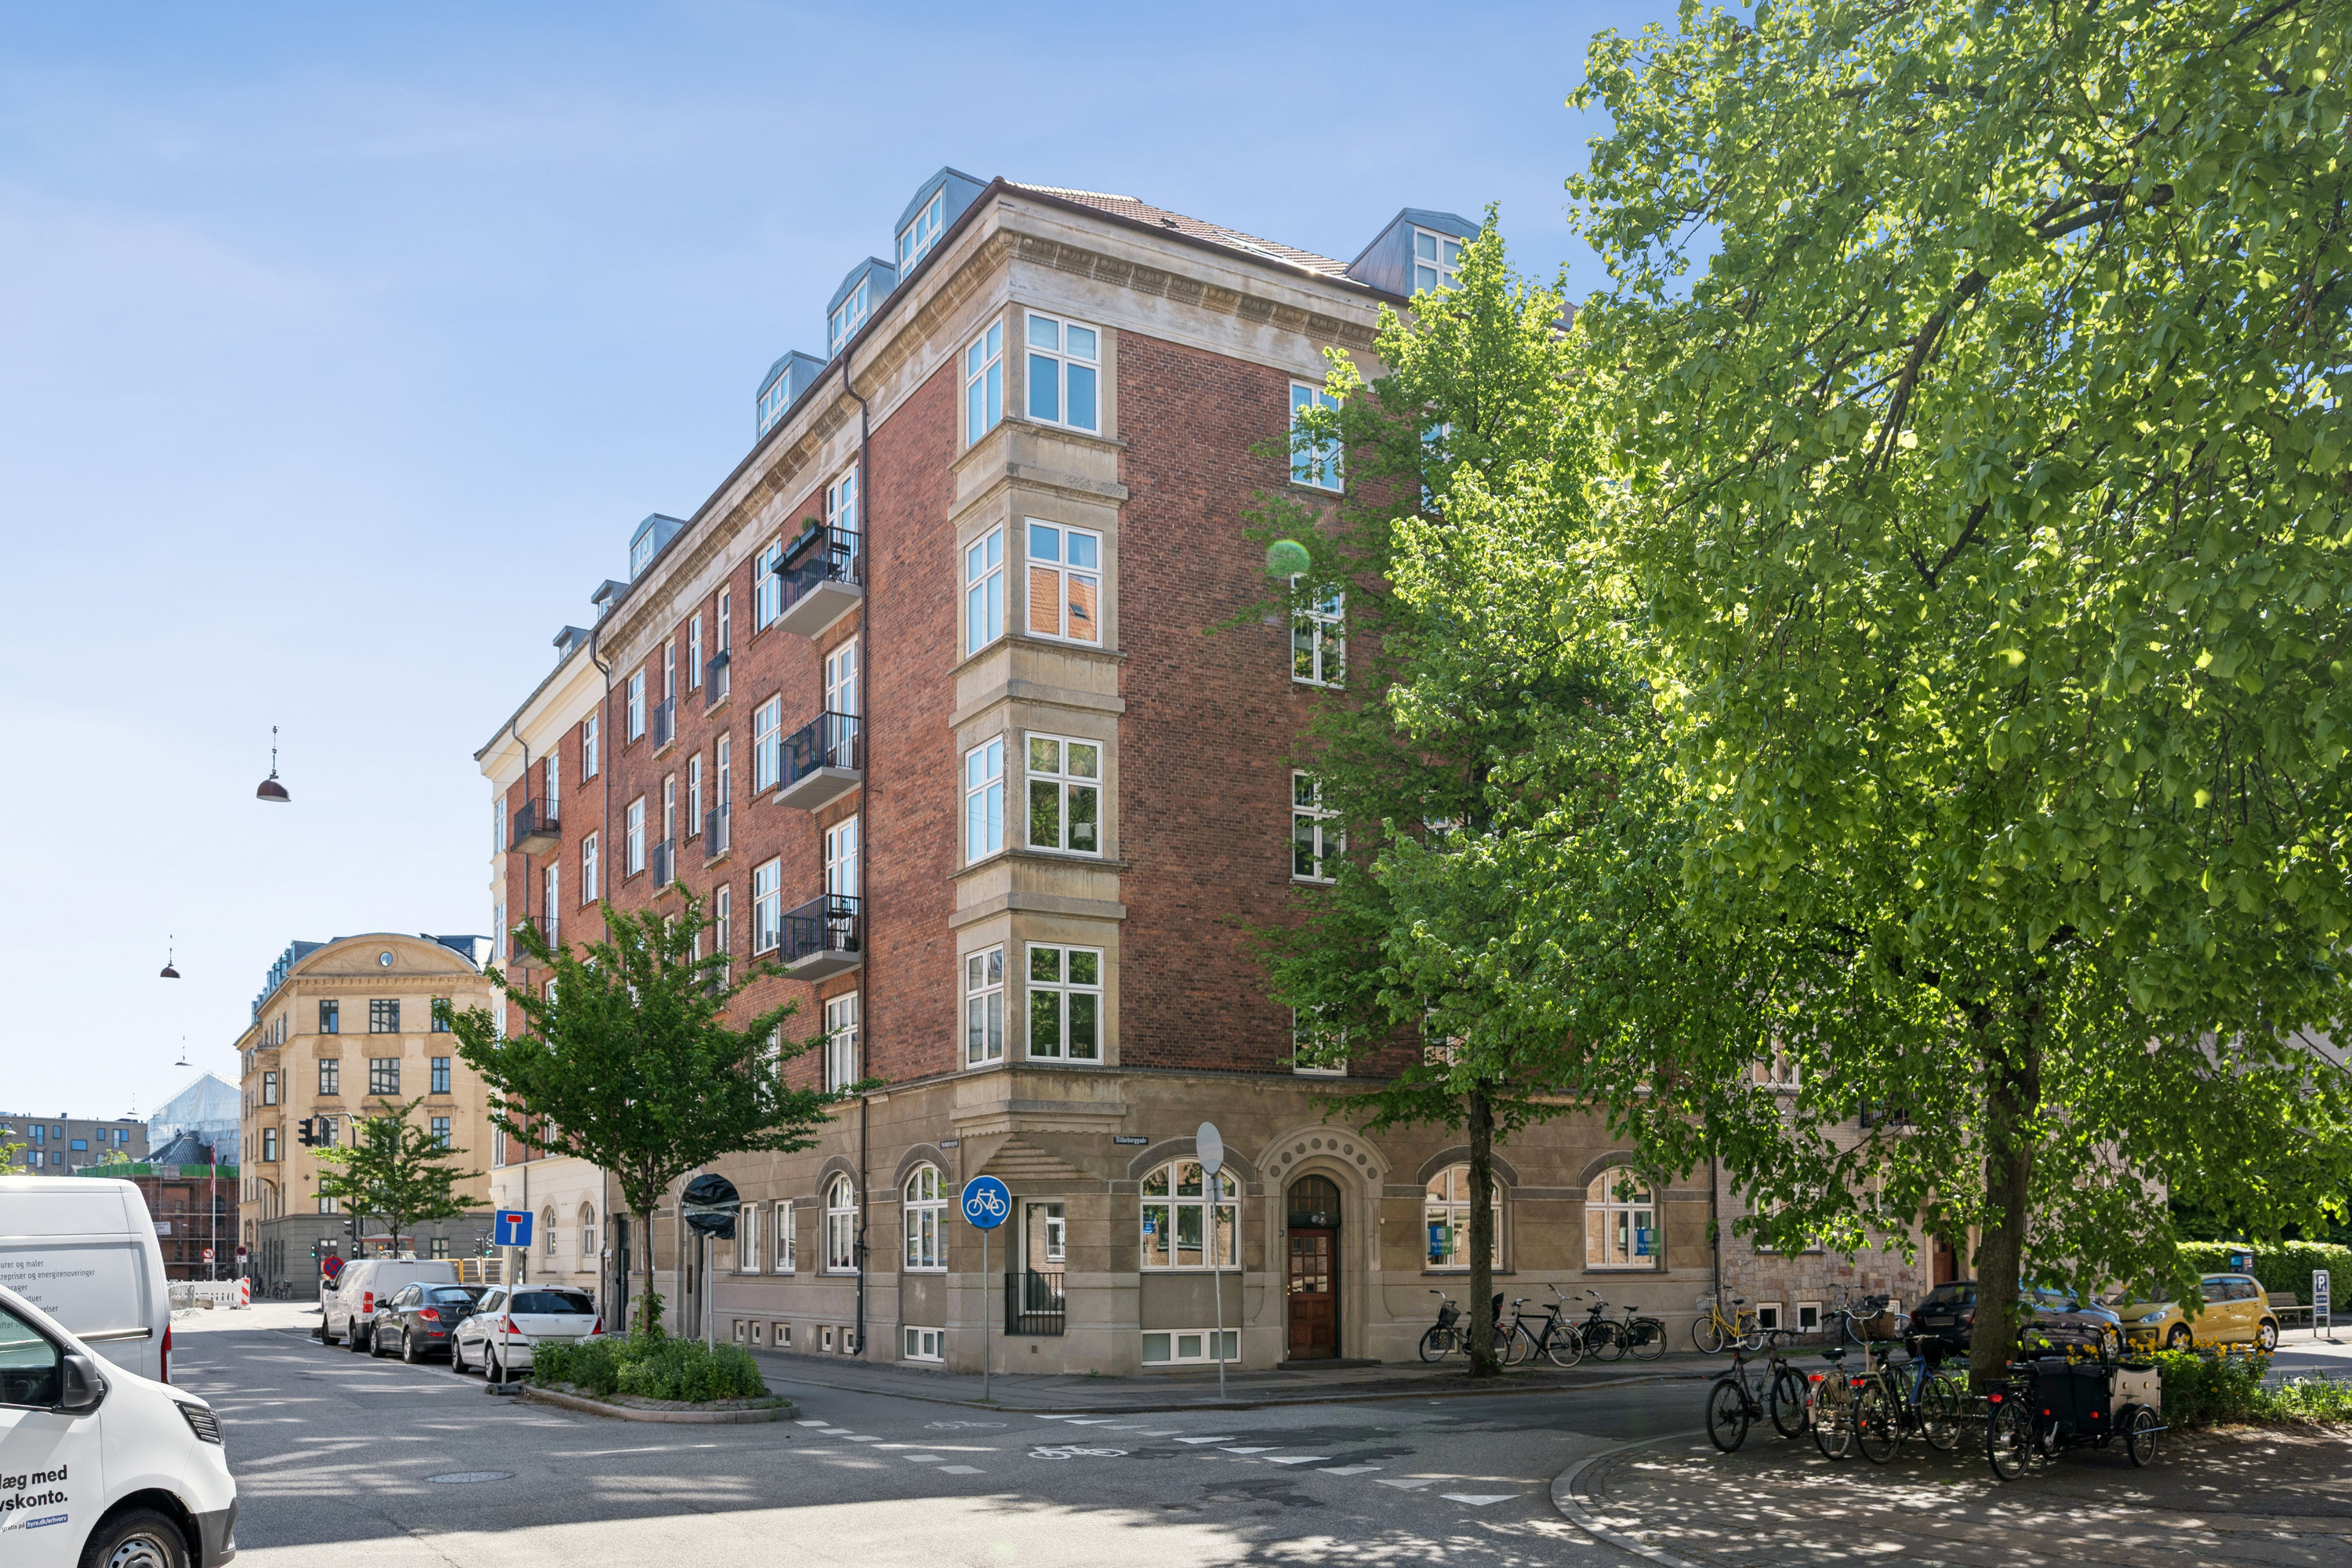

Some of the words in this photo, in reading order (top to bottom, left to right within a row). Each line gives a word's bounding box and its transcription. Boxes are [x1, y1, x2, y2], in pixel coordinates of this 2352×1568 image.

[0, 1272, 26, 1281] repriser
[38, 1269, 95, 1279] energirenoveringer
[2318, 1276, 2325, 1289] P
[32, 1465, 67, 1484] med
[2, 1523, 17, 1533] gratis
[18, 1522, 25, 1530] på
[27, 1515, 67, 1528] hyre.dk/erhverv
